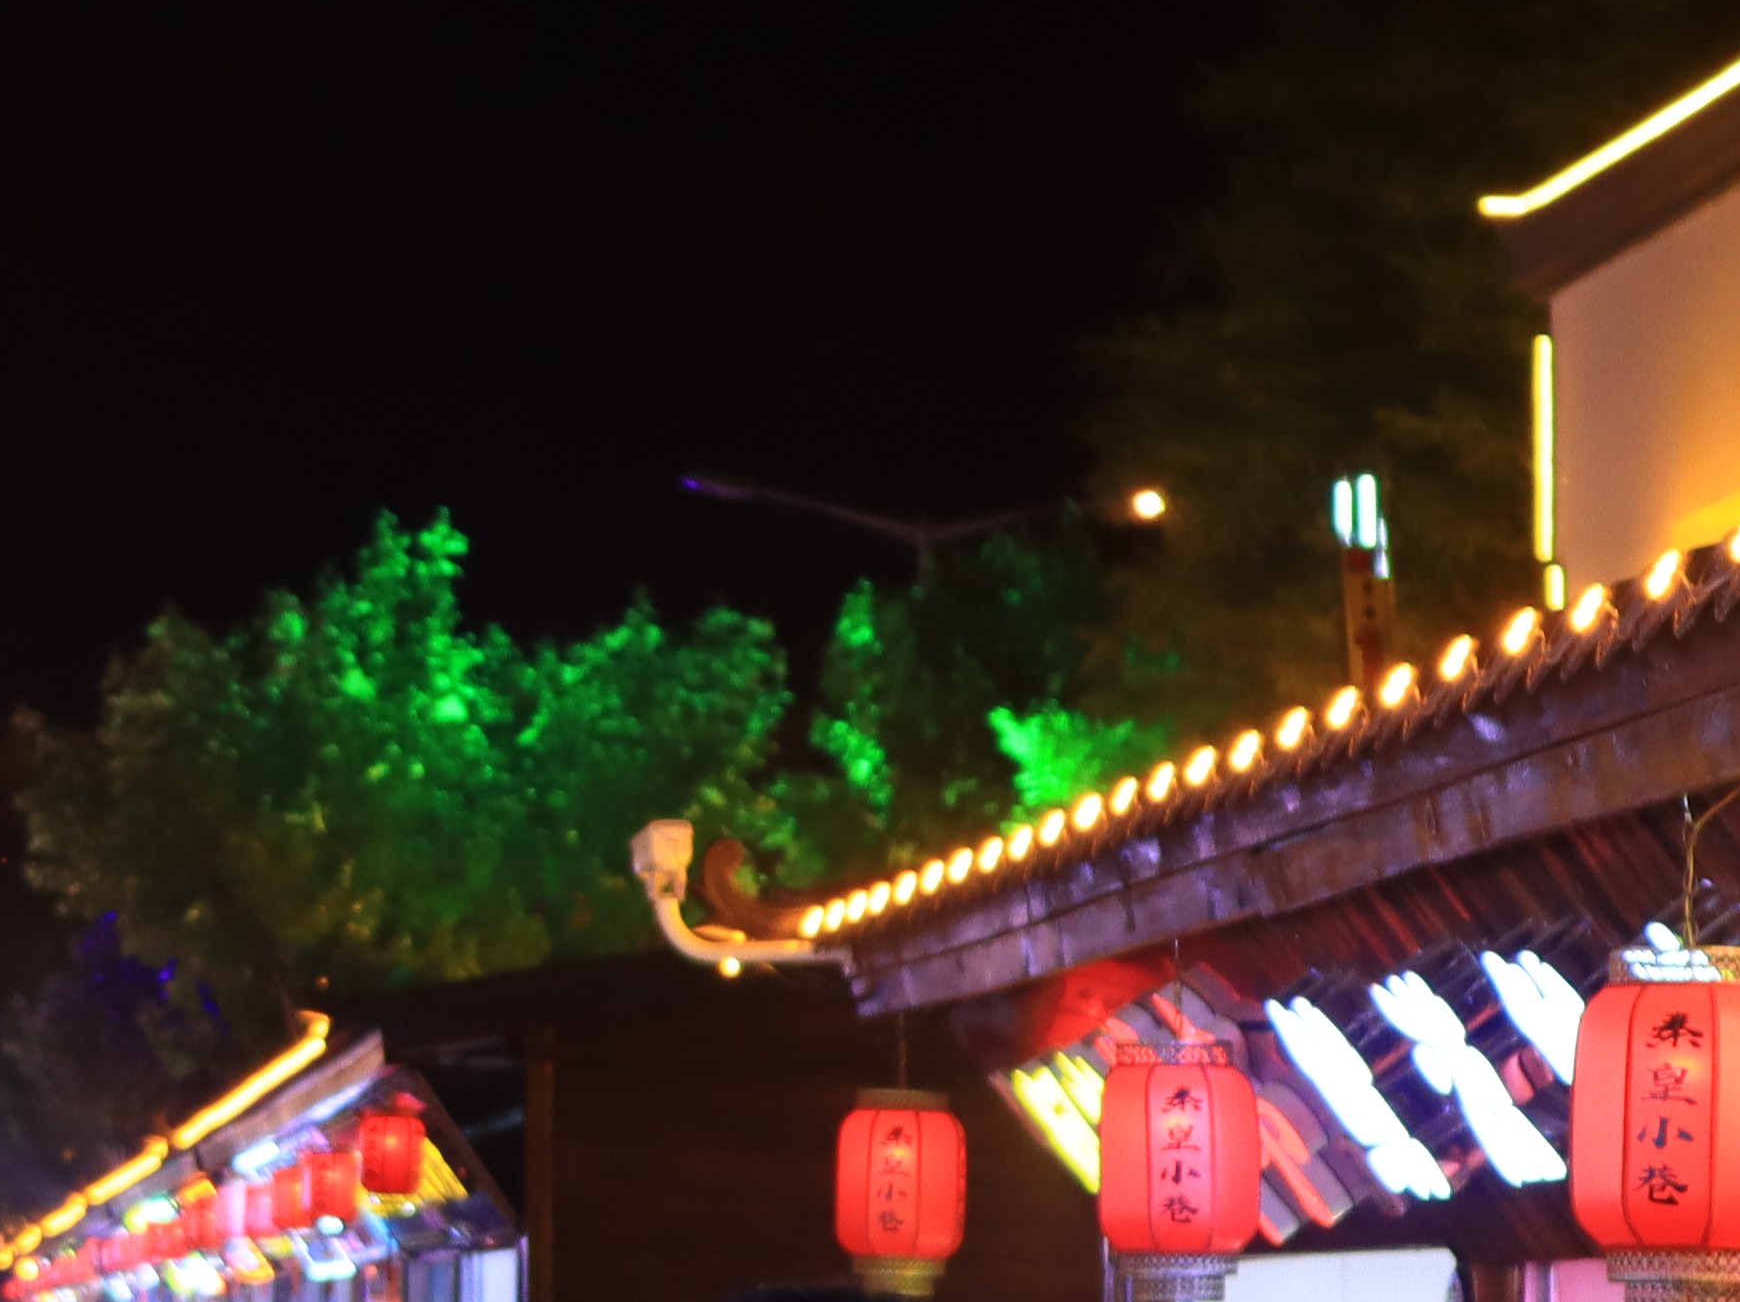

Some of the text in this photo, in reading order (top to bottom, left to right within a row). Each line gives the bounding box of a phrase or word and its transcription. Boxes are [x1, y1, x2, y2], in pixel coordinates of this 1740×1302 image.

[1159, 1087, 1203, 1225] 秦皇小巷
[1632, 1010, 1704, 1205] 秦皇小巷
